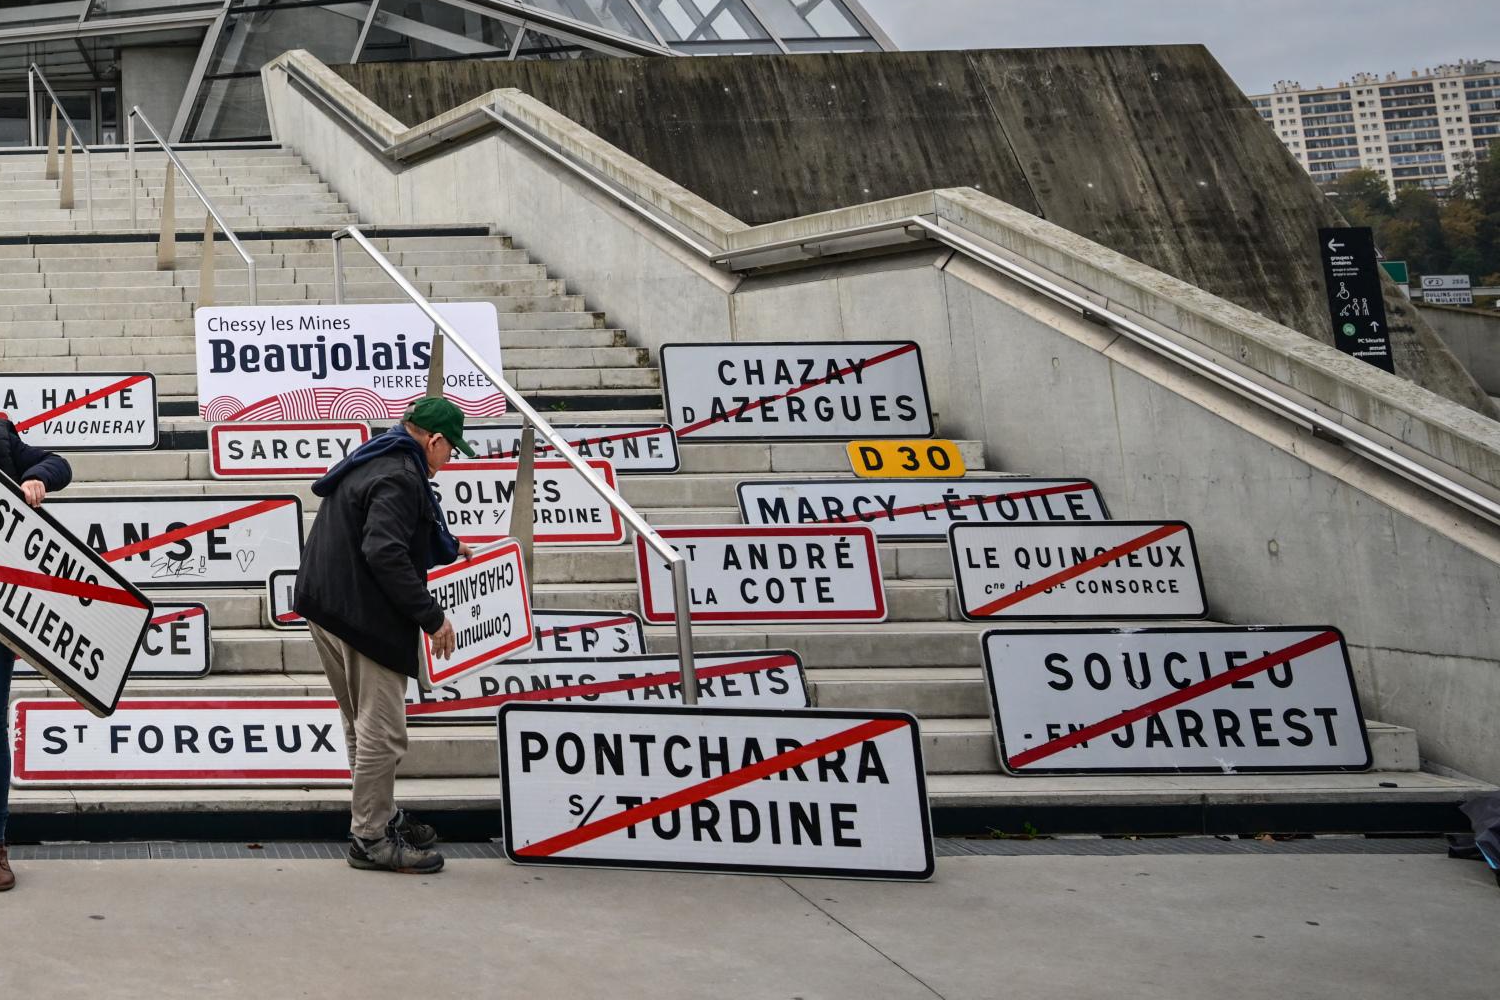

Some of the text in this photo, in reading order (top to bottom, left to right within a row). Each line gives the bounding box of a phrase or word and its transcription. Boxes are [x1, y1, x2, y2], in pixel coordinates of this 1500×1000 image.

[207, 315, 351, 336] Chessy les Mines
[208, 333, 431, 380] Beaujolais
[717, 358, 866, 387] CHAZAY
[682, 394, 918, 424] D AZERGUES
[43, 420, 146, 435] VAUGNERAY
[227, 437, 352, 461] SARCEY
[859, 445, 952, 472] D 30
[757, 495, 897, 525] MARCY
[86, 521, 232, 562] ANSE
[723, 536, 855, 571] ANDRÉ
[965, 547, 1000, 569] LE
[691, 576, 835, 605] LA COTE
[1076, 579, 1180, 594] CONSORCE
[471, 604, 482, 620] de
[1044, 650, 1295, 692] SOUCIEU
[42, 723, 337, 755] ST FORGEUX
[1110, 707, 1341, 749] JARREST
[520, 730, 891, 786] PONTCHARRA
[615, 795, 863, 849] TURDINE
